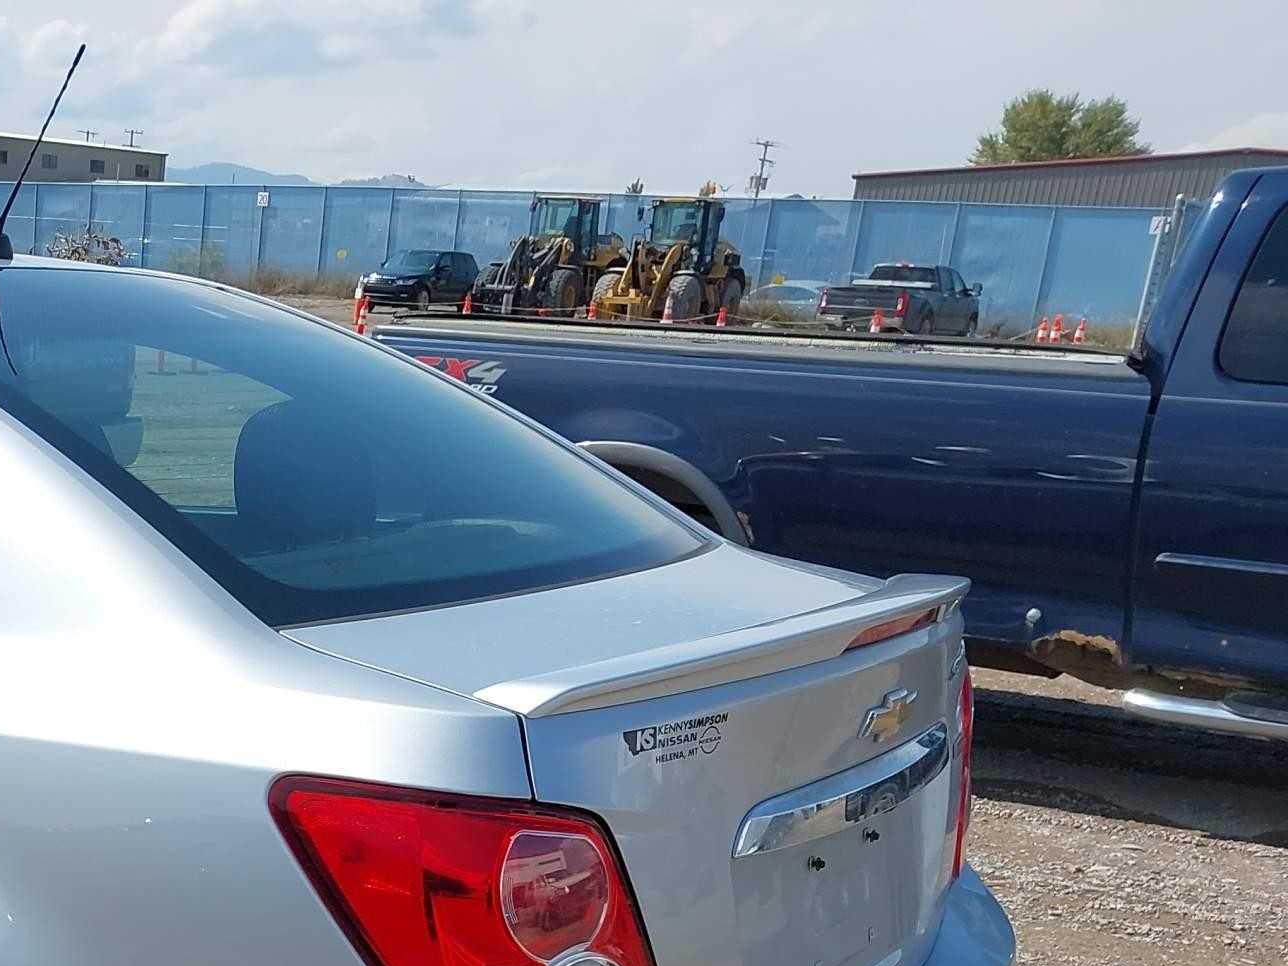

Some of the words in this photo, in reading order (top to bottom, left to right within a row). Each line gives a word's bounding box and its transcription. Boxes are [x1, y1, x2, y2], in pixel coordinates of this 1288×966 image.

[636, 728, 655, 751] KS
[657, 732, 698, 749] NISSAN
[655, 751, 686, 764] HELENA,
[688, 747, 699, 758] MT
